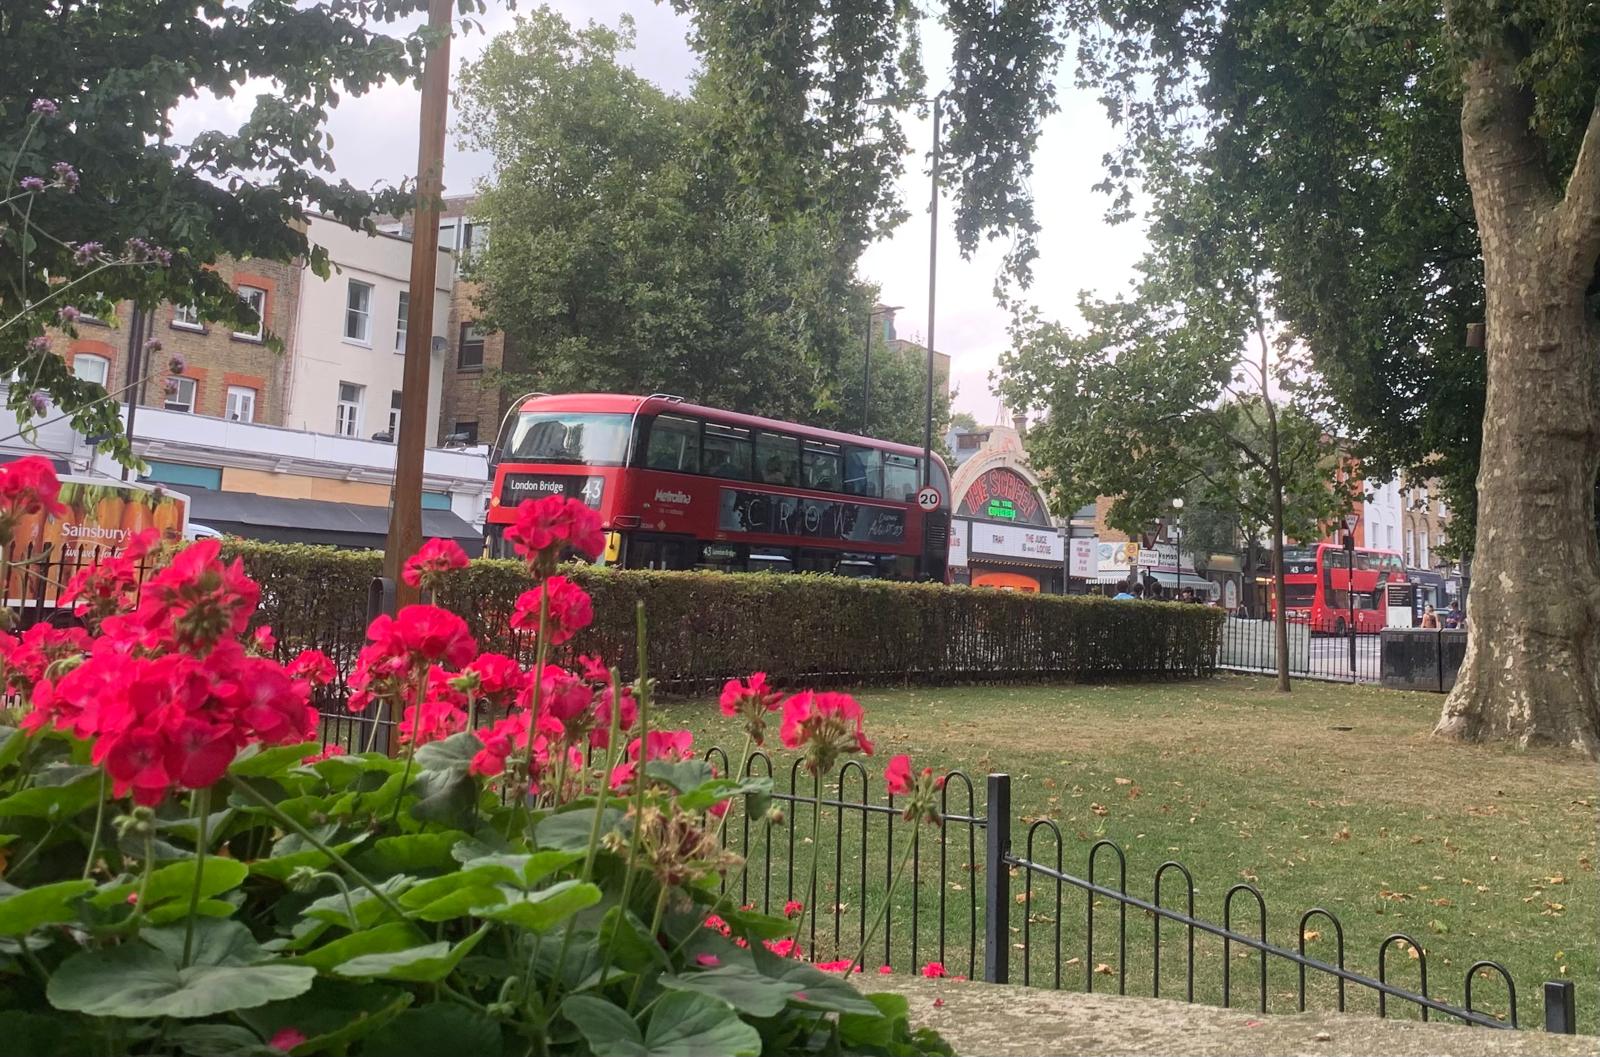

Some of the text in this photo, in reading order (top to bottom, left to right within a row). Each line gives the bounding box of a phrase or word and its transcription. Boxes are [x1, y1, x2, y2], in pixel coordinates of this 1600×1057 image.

[511, 479, 601, 499] London Bridge 43
[990, 469, 1038, 519] SCREEN
[920, 493, 938, 505] 20
[703, 546, 712, 557] 43
